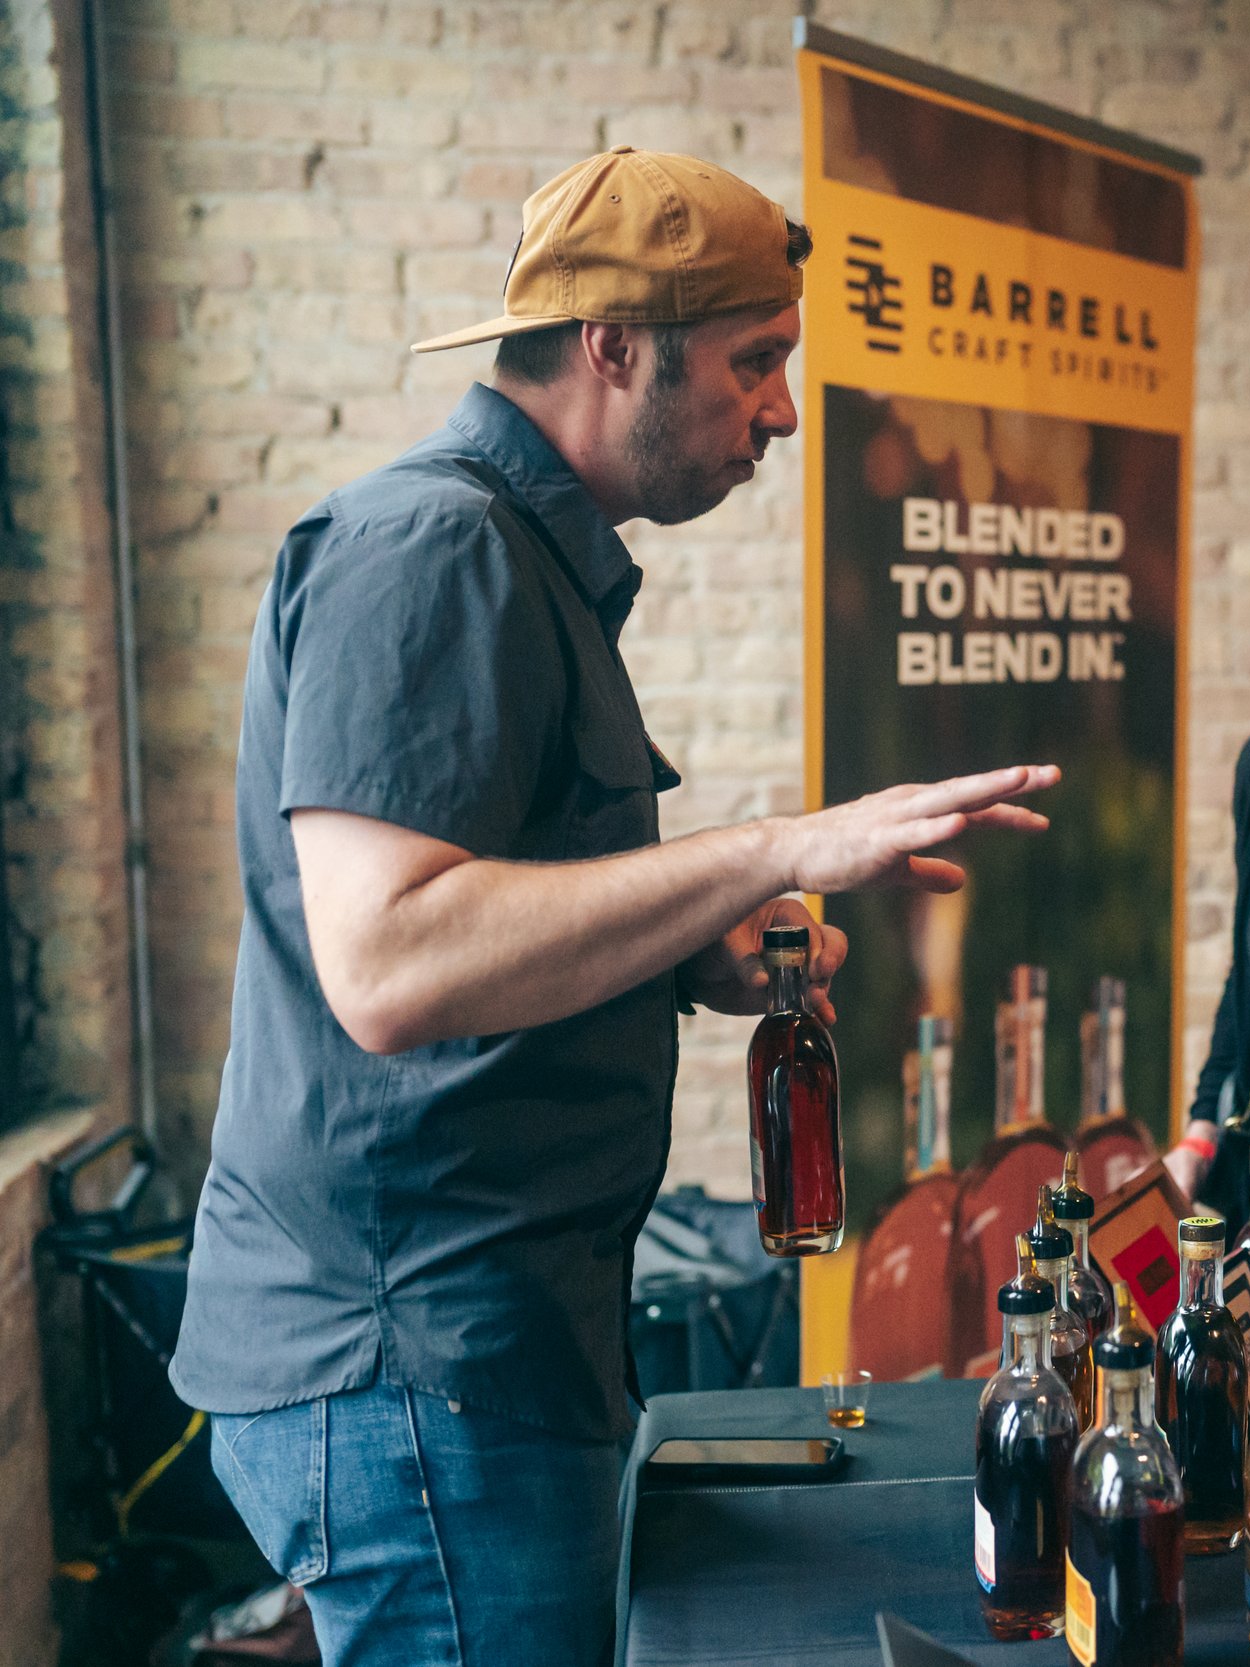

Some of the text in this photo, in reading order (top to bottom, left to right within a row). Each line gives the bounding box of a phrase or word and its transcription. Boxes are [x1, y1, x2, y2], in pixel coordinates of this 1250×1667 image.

[930, 262, 1158, 350] BARRELL
[927, 326, 1159, 393] CRAFT SPIRITS
[902, 496, 1125, 562] BLENDED
[889, 564, 1133, 623] TO NEVER
[897, 631, 1063, 686] BLEND
